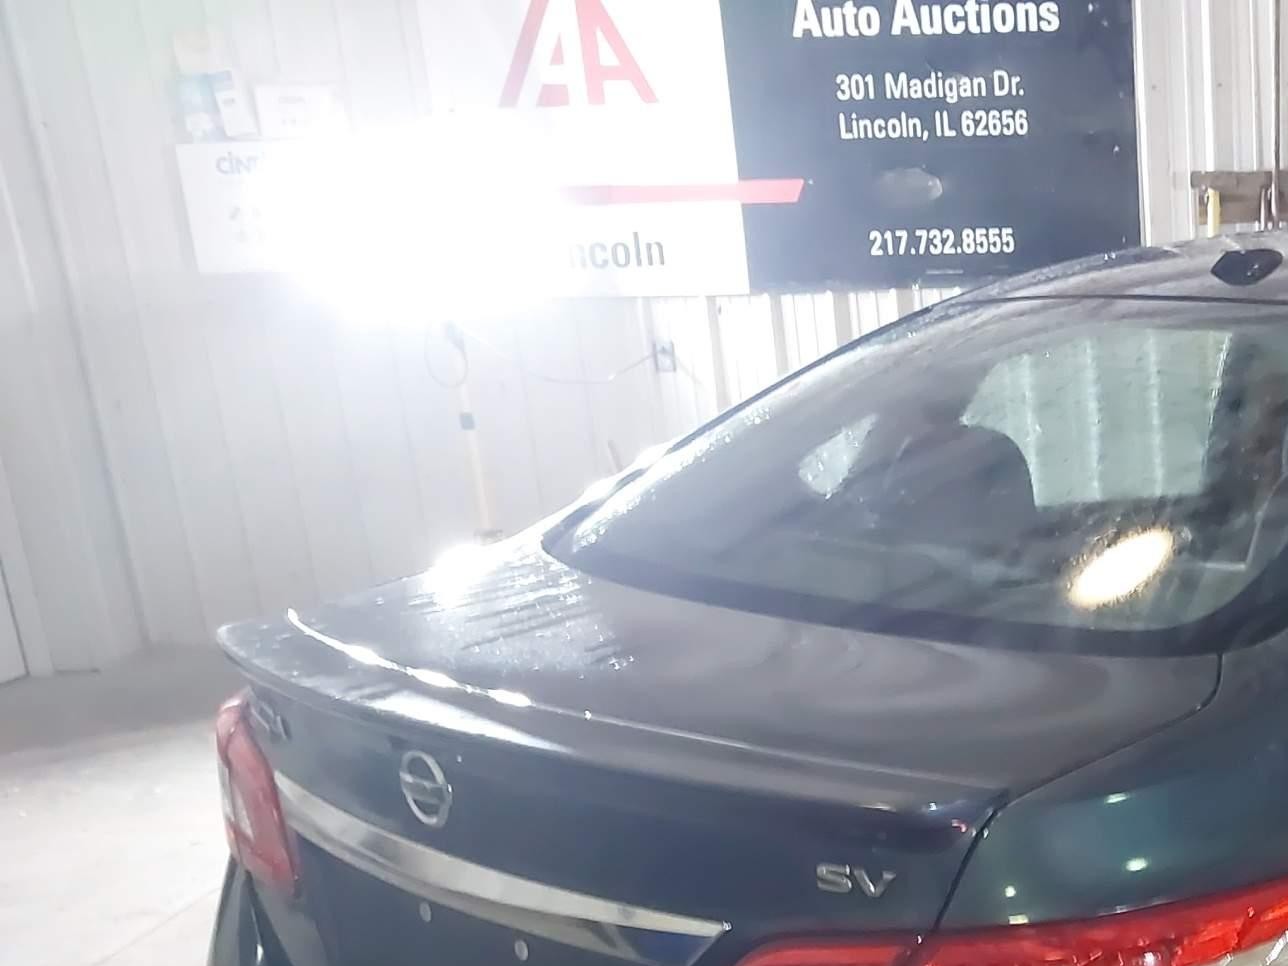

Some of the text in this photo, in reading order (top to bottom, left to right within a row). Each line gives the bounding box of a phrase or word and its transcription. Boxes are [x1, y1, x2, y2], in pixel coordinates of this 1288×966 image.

[792, 0, 1060, 38] Auto Auctions
[835, 70, 1025, 103] 301 Madigan Dr.
[839, 109, 1029, 142] Lincoln, IL 62656
[567, 231, 665, 269] ncoln
[869, 227, 1015, 257] 217.732.8555
[815, 862, 897, 898] SV
